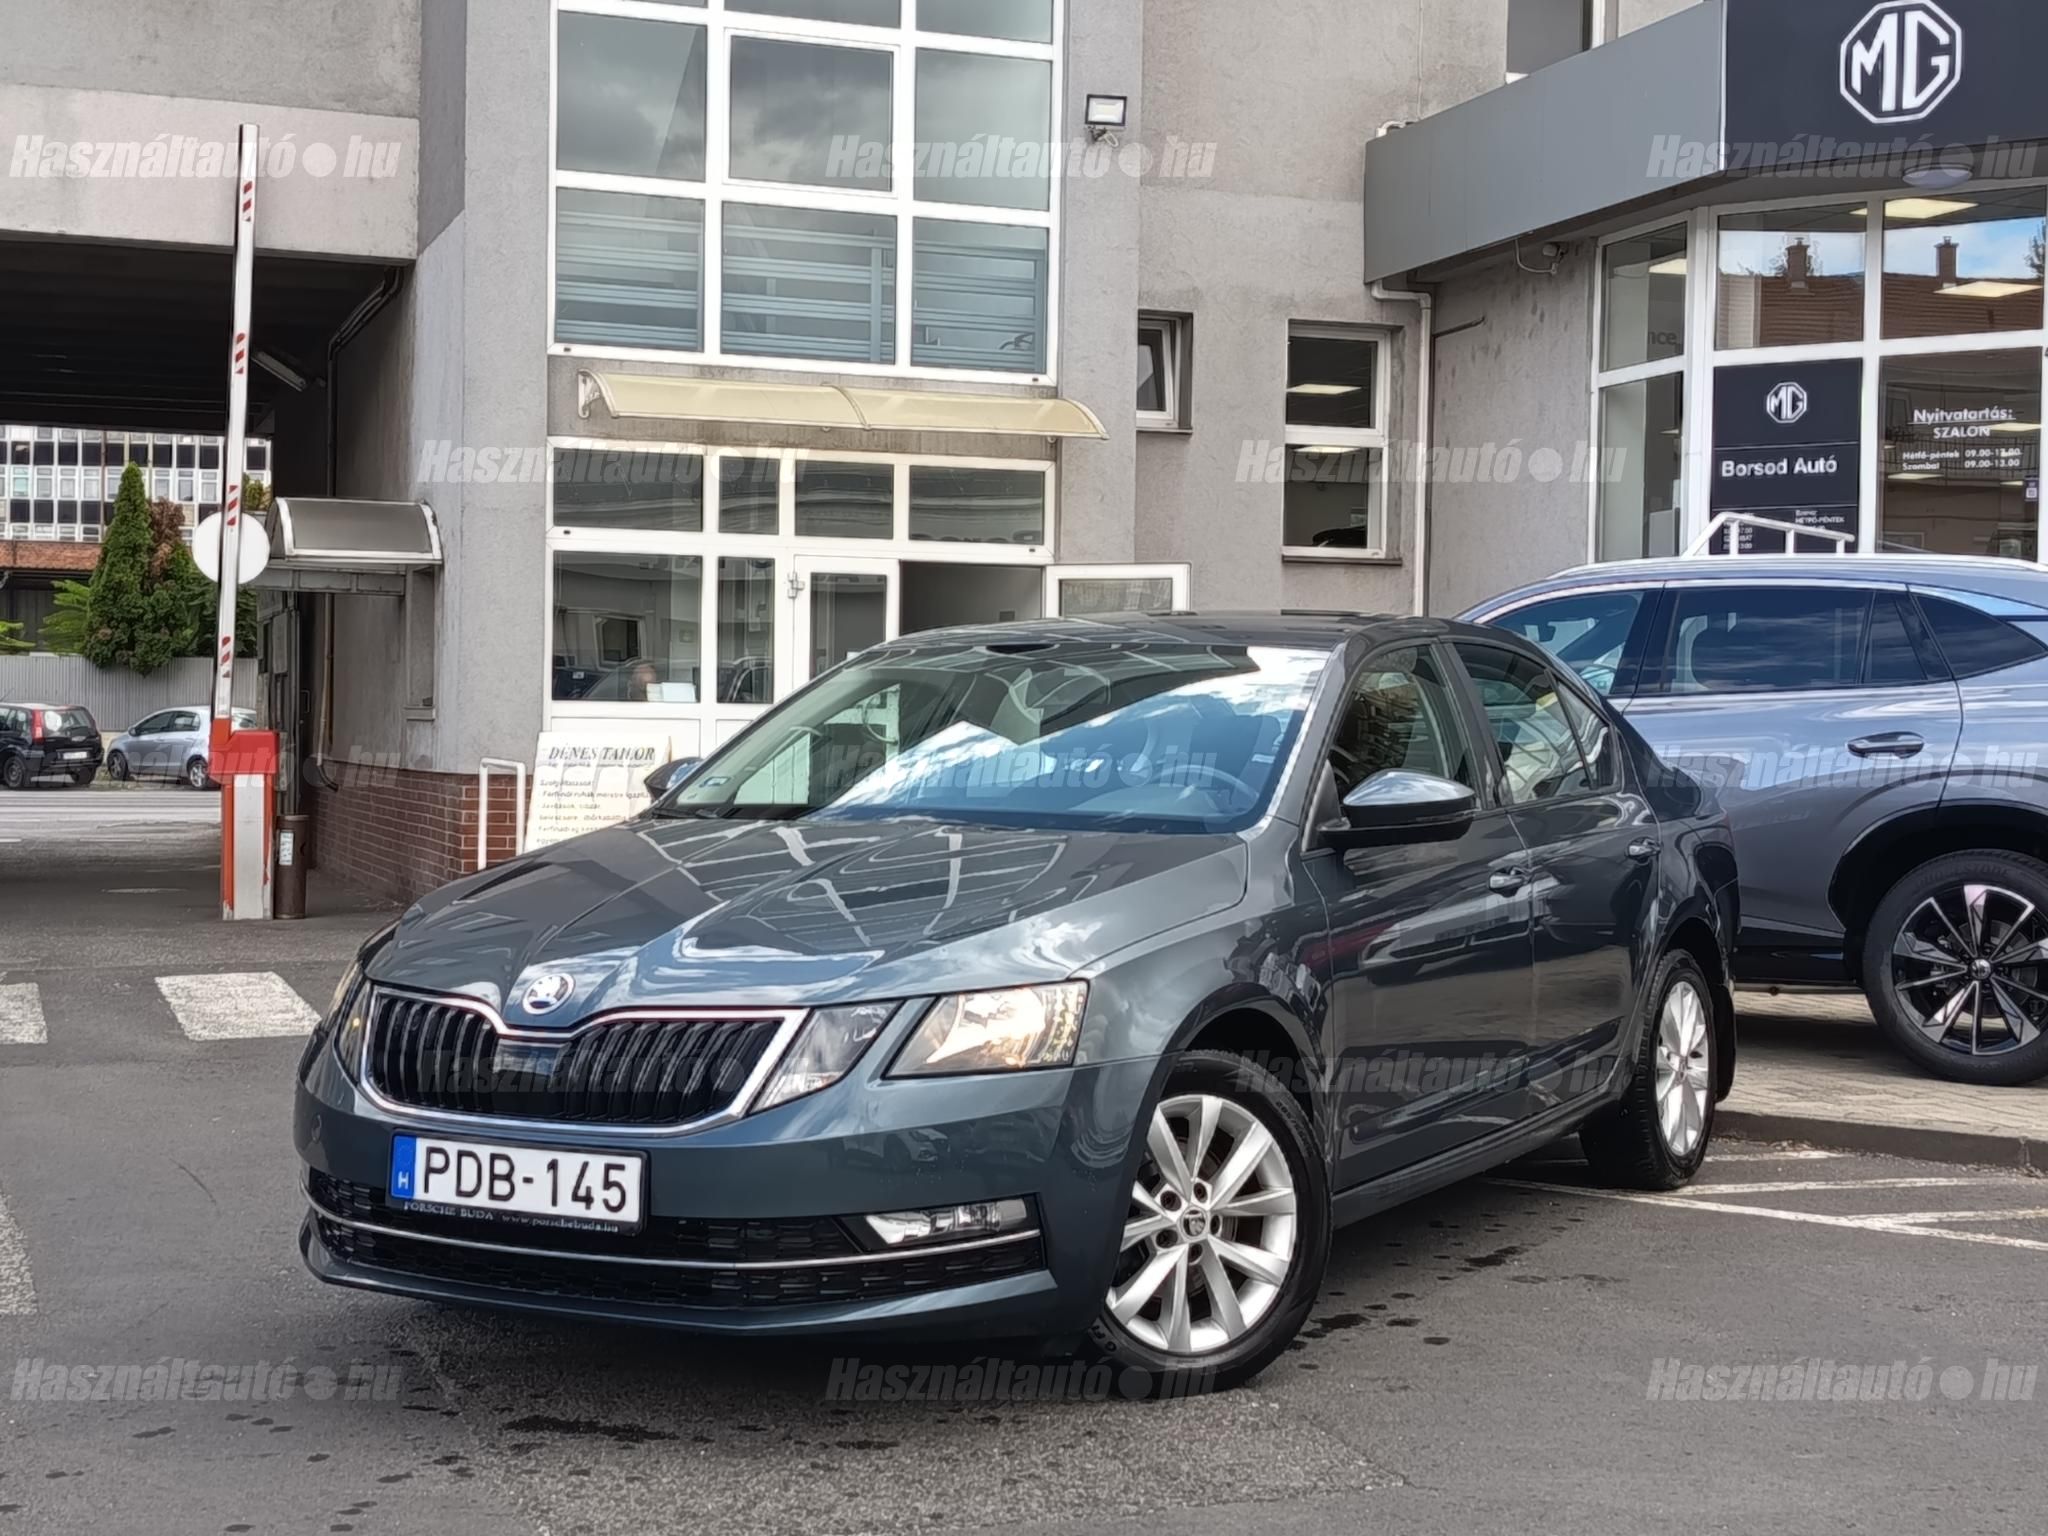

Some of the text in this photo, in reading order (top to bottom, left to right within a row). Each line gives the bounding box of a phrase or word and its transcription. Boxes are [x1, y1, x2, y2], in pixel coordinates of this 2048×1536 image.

[1849, 6, 1953, 115] MG
[1768, 384, 1805, 421] MG
[1913, 406, 2013, 425] Nyitvatartás:
[1933, 426, 1991, 439] SZALON
[1721, 455, 1838, 478] Borsod Autó
[397, 1146, 626, 1213] H PDB-145
[404, 1200, 456, 1217] PORSCHE
[460, 1206, 494, 1221] BUDA
